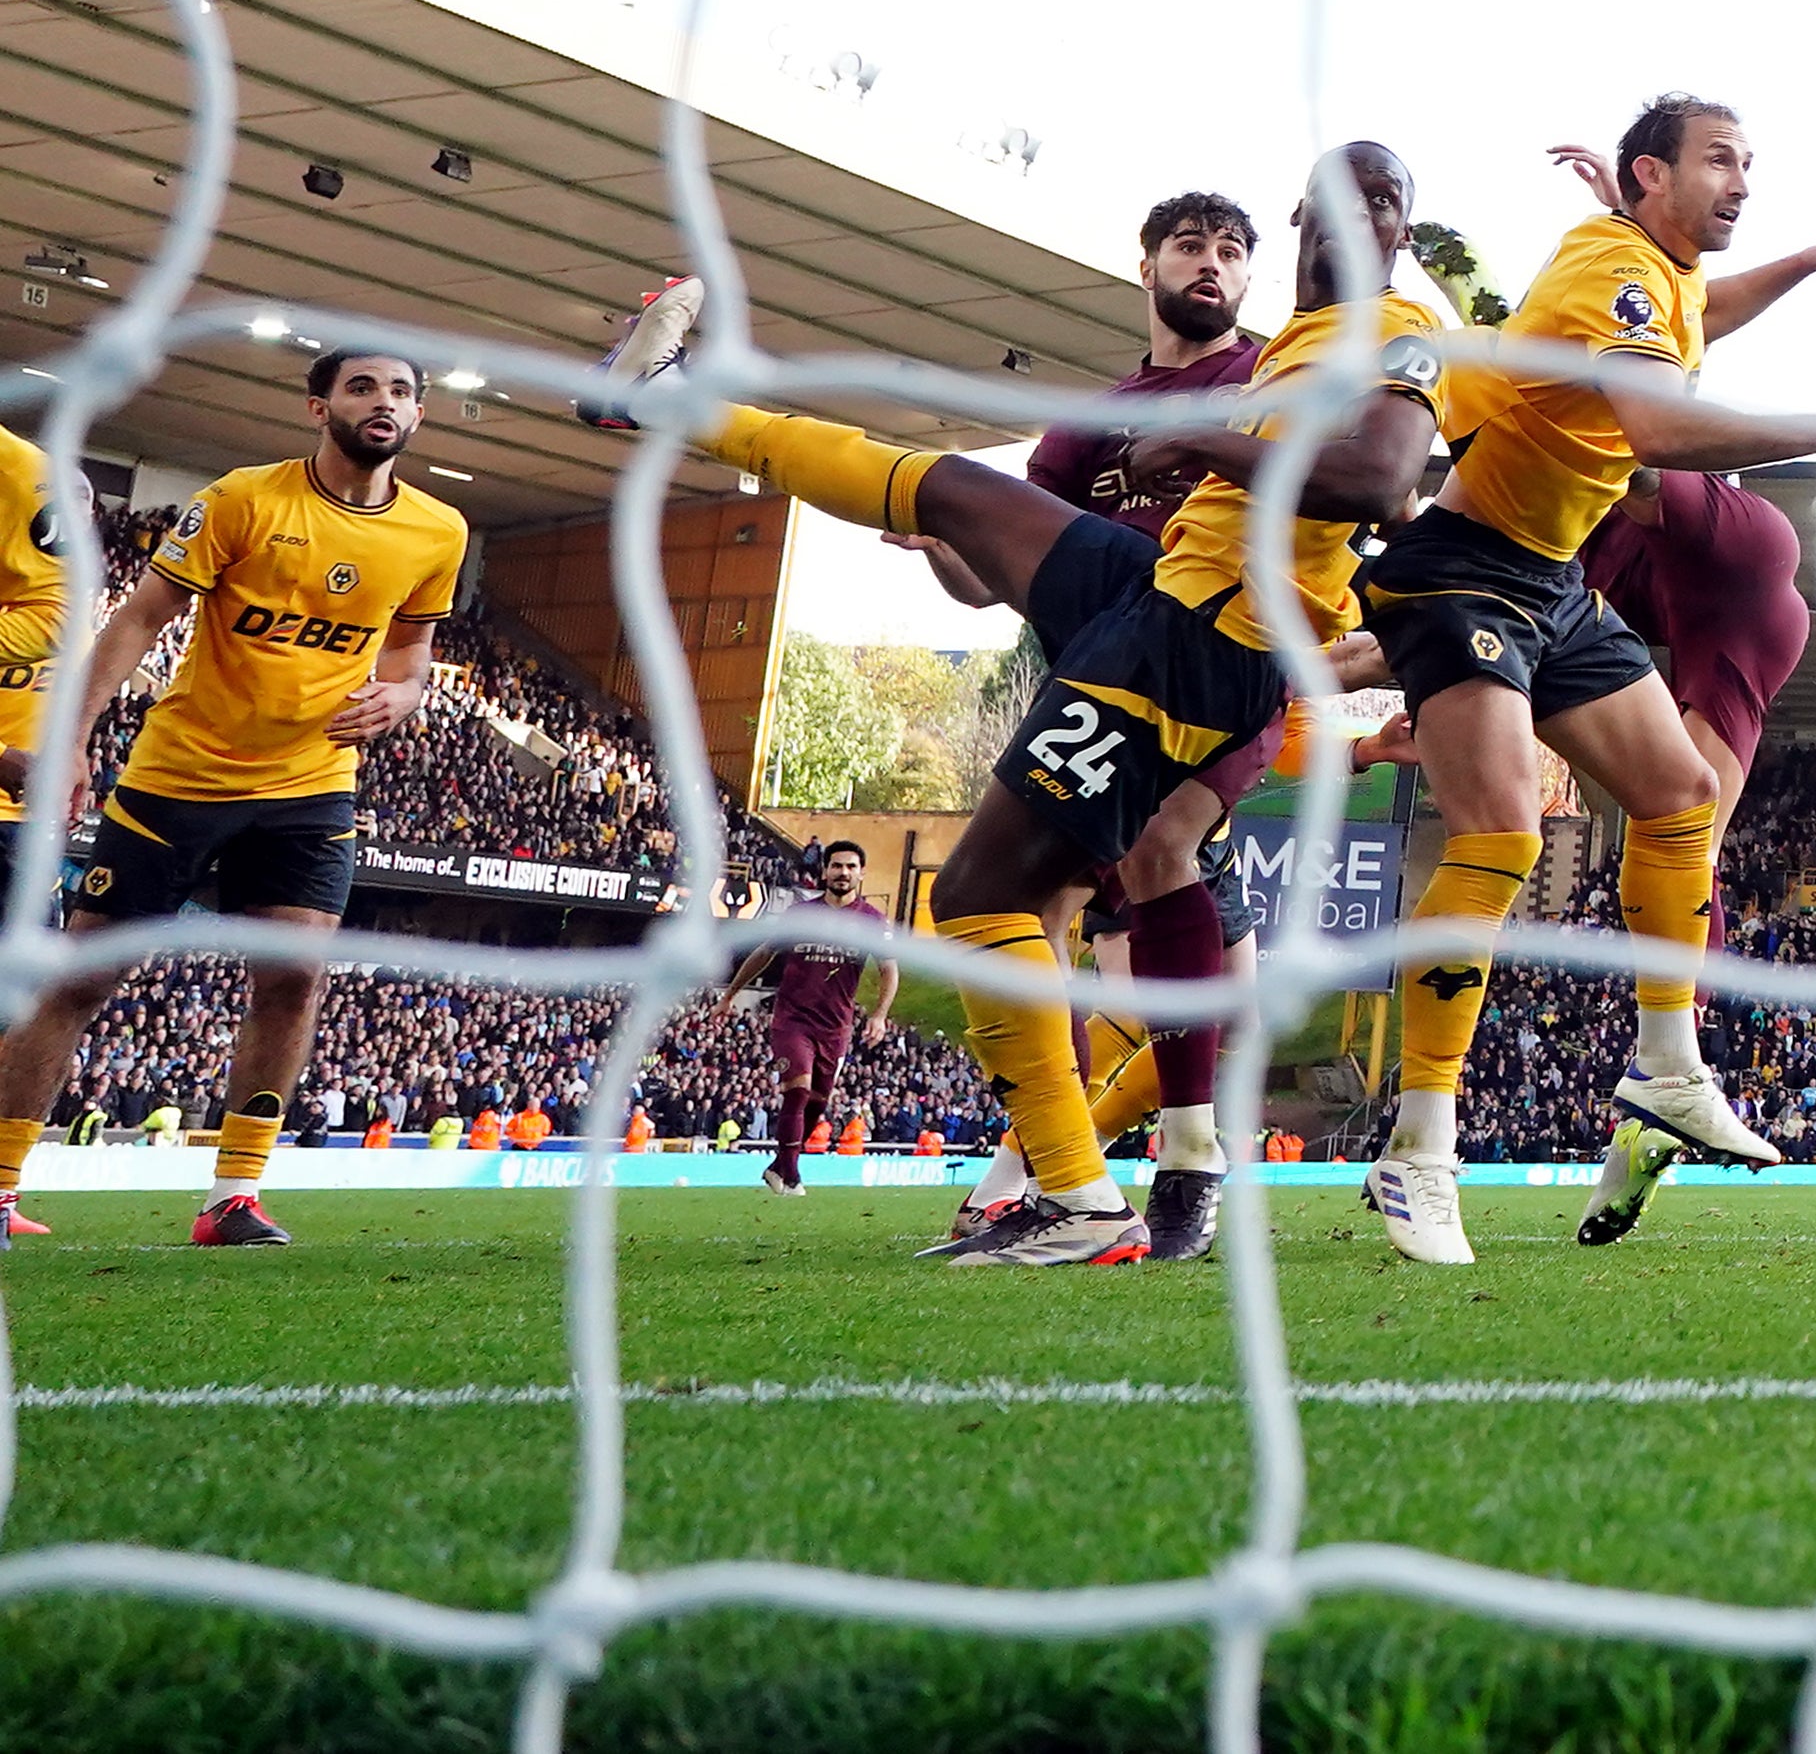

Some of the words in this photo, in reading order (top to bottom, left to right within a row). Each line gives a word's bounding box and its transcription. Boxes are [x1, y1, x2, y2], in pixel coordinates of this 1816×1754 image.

[1611, 266, 1650, 276] SUDU
[25, 287, 45, 305] 15
[1384, 345, 1437, 381] JD
[269, 533, 310, 547] SUDU
[232, 604, 379, 655] DEBET
[1026, 701, 1127, 799] 24
[1027, 768, 1074, 801] SUDU
[364, 846, 392, 870] The
[393, 849, 433, 875] home
[465, 854, 558, 895] EXCLUSIVE
[556, 866, 631, 901] CONTENT
[1242, 834, 1386, 891] M&E
[1247, 889, 1381, 930] Global
